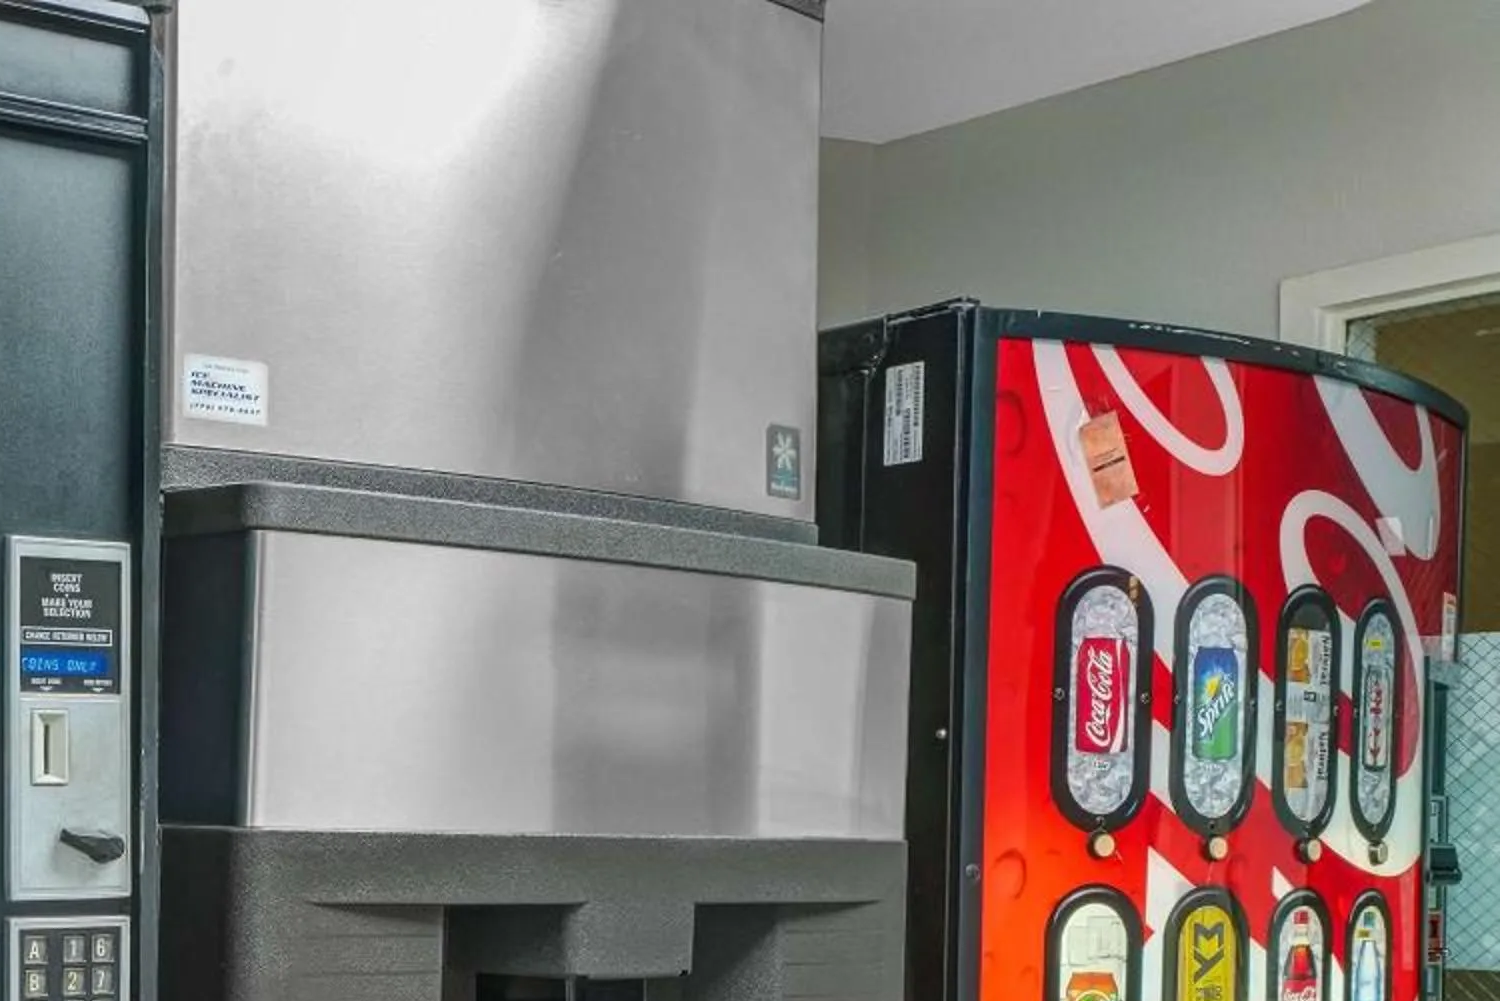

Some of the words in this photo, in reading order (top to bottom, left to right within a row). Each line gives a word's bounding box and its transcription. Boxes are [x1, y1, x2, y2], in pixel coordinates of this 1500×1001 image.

[43, 607, 92, 619] SELECTION
[1085, 644, 1114, 747] Coca-Cola
[1197, 676, 1237, 743] Sprite
[28, 941, 40, 960] A
[69, 941, 77, 957] 1
[96, 938, 106, 957] 6
[28, 974, 39, 993] B
[67, 972, 77, 990] 2
[96, 971, 105, 988] 7
